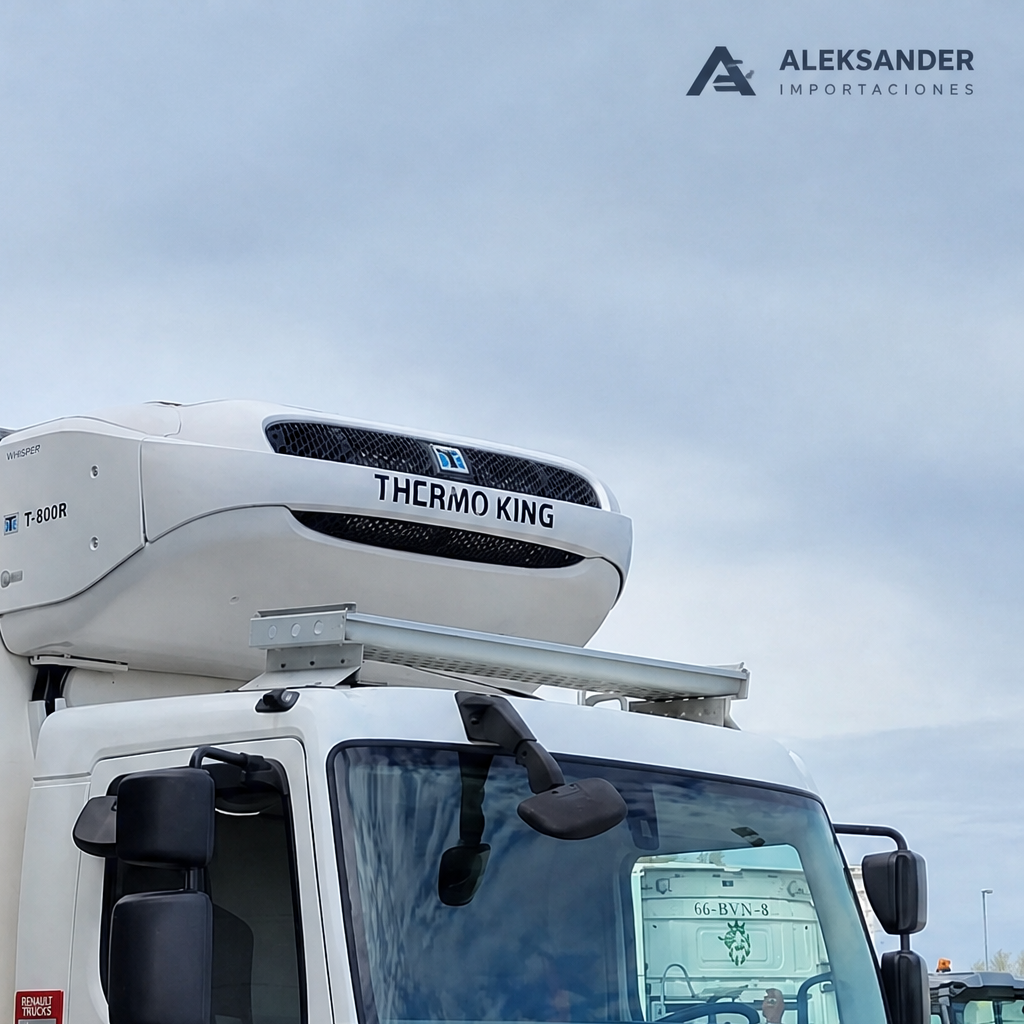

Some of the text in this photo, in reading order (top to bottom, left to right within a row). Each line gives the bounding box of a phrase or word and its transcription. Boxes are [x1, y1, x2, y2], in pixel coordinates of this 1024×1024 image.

[6, 444, 41, 461] WHISPER
[24, 502, 67, 527] T-800R
[496, 496, 554, 529] KING
[694, 902, 769, 917] 66-BVN-8
[21, 996, 53, 1007] RENAULT
[21, 1006, 52, 1017] TRUCKS
